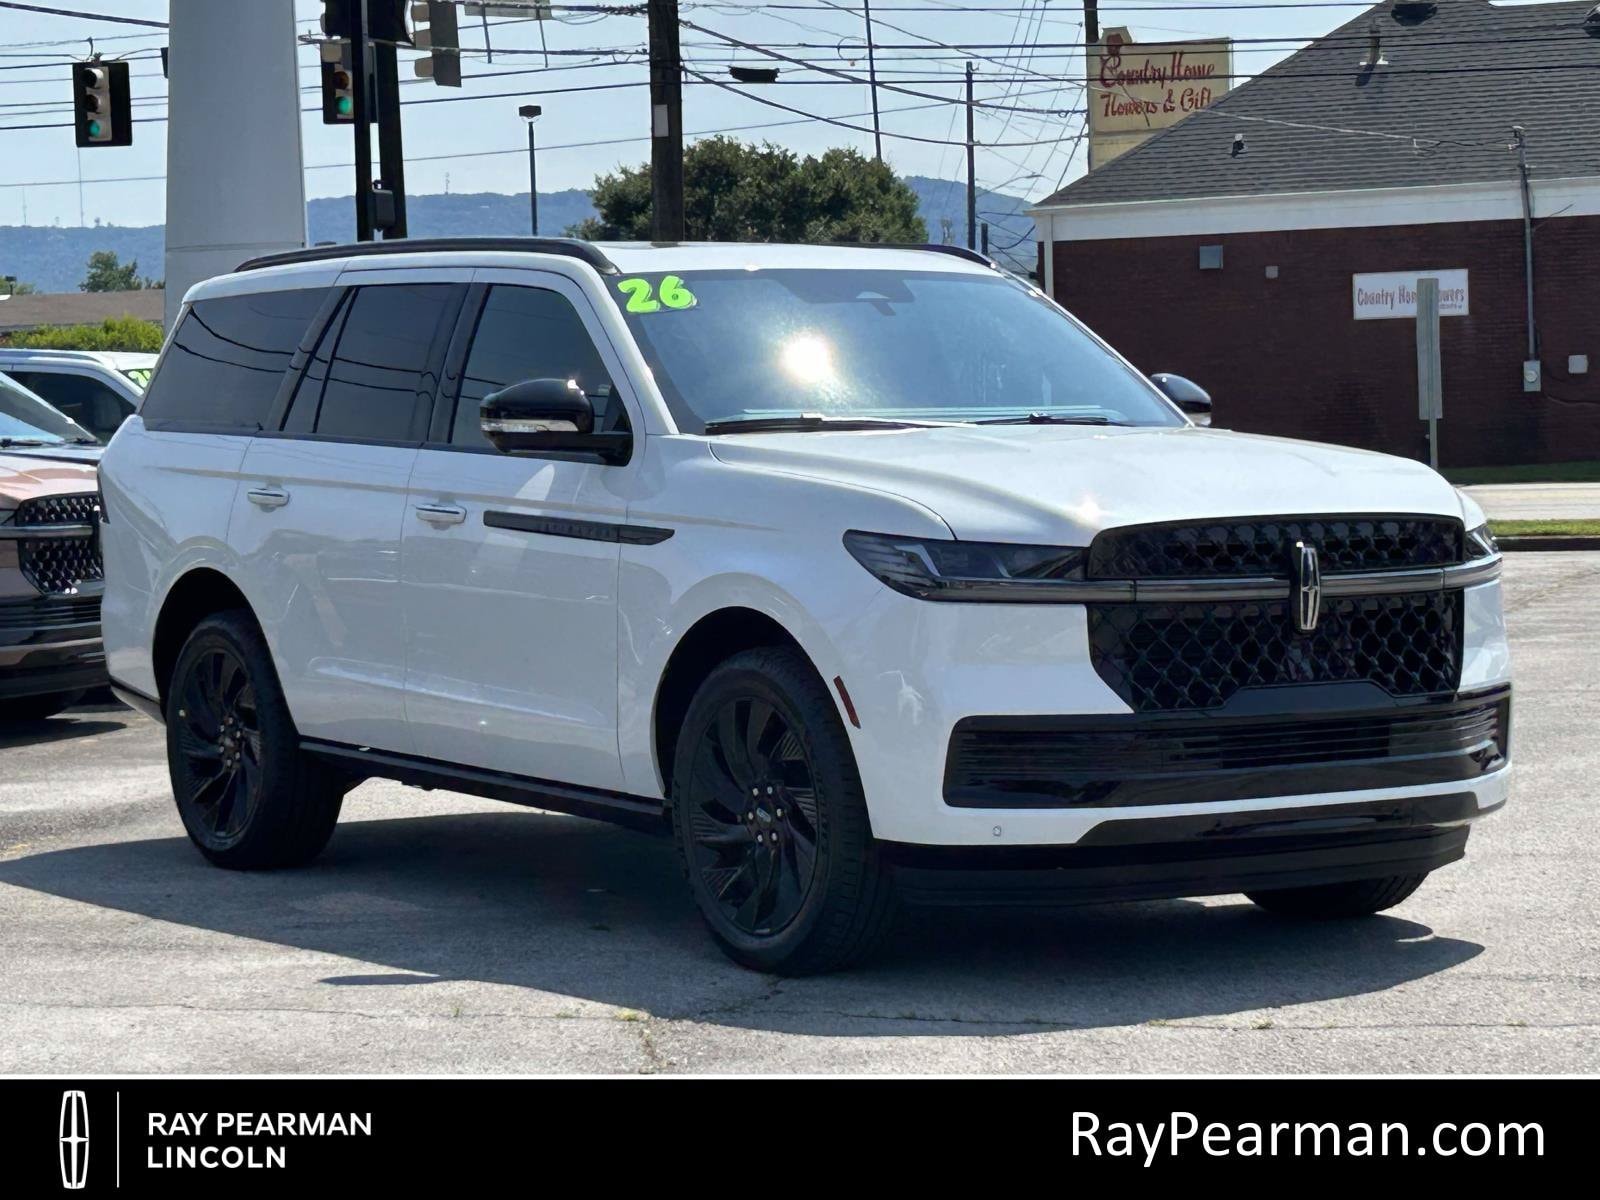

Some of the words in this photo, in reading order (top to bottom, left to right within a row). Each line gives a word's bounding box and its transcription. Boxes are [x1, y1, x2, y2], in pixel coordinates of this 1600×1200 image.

[1100, 55, 1167, 89] Country
[1170, 50, 1215, 83] Home
[1100, 92, 1159, 118] Flowers
[1163, 88, 1177, 113] &
[617, 275, 697, 313] 26
[1357, 287, 1395, 310] Country
[1398, 285, 1417, 305] Ho
